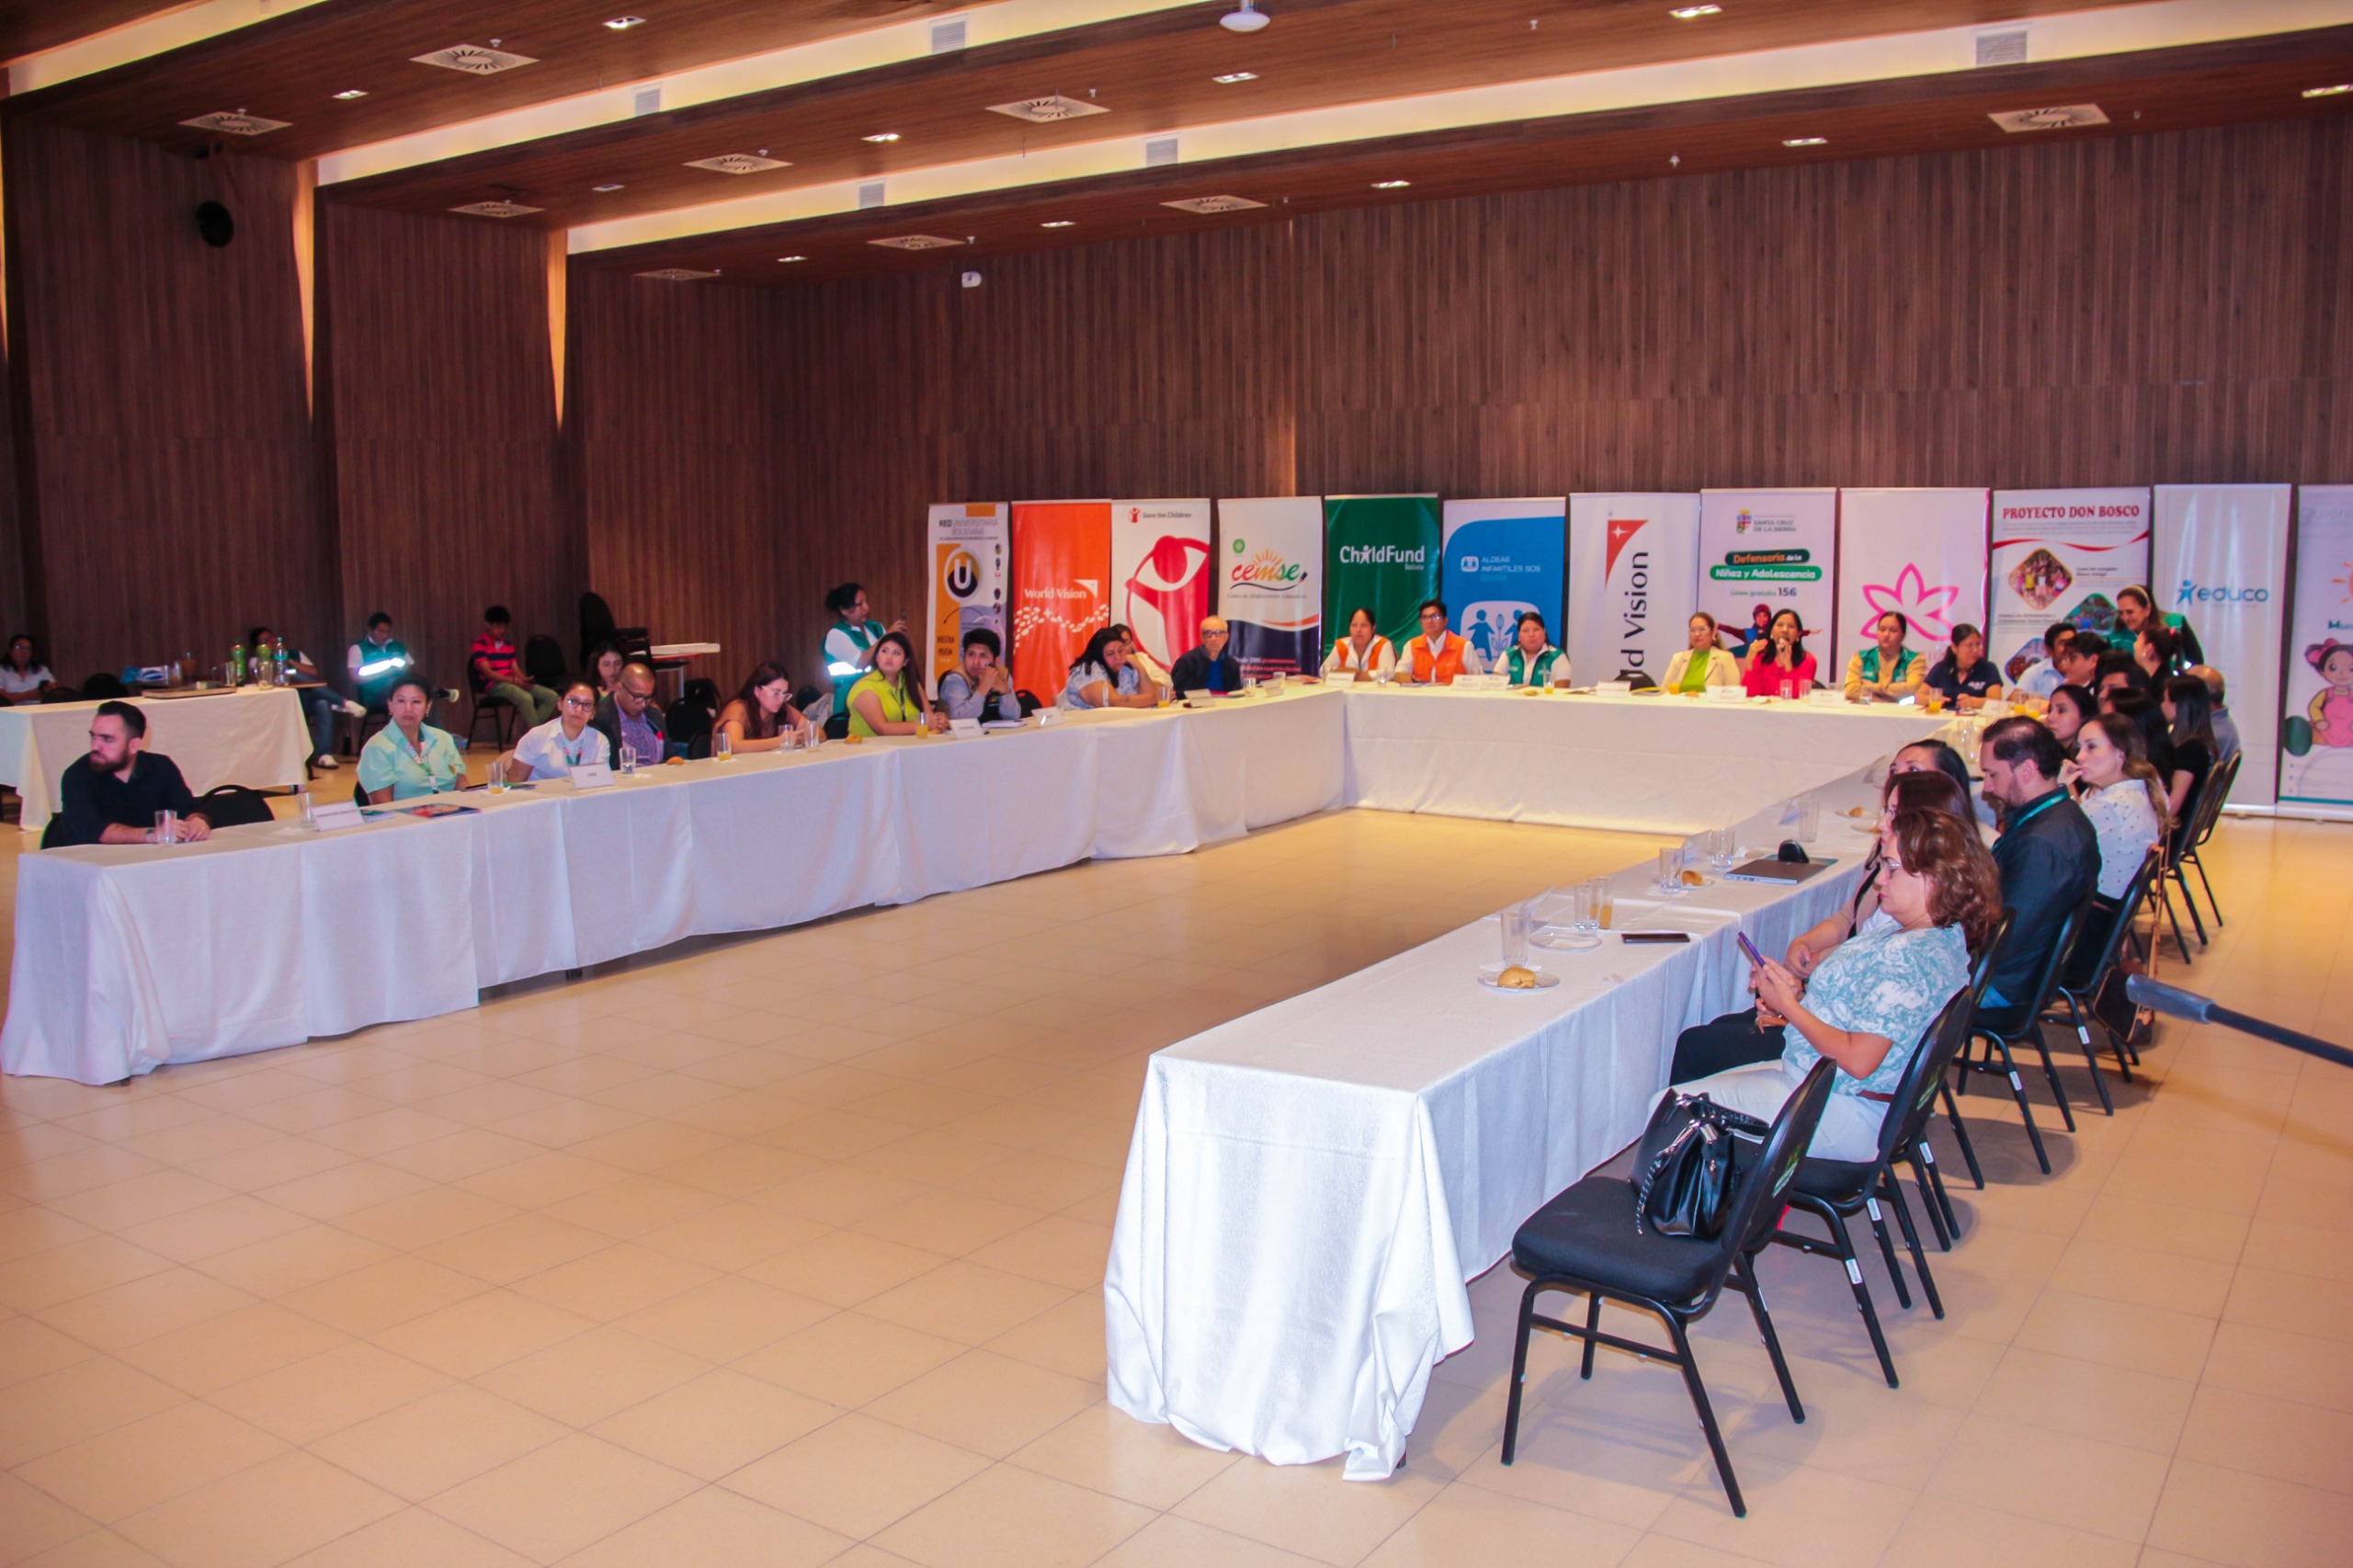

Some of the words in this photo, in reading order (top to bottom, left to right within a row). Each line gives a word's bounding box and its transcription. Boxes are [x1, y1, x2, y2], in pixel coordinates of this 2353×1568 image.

[2002, 506, 2066, 519] PROYECTO
[2069, 506, 2096, 518] DON
[2098, 505, 2140, 517] BOSCO
[1339, 544, 1425, 564] ChildFund
[952, 557, 972, 590] U
[1232, 562, 1301, 582] cemse
[1715, 568, 1743, 577] Niñez
[1744, 571, 1751, 579] y
[1751, 569, 1816, 579] Adolescencia
[1024, 588, 1055, 599] World
[1056, 588, 1087, 599] Vision
[1623, 551, 1649, 640] Vision
[1778, 587, 1797, 597] 156
[2197, 585, 2268, 602] educo
